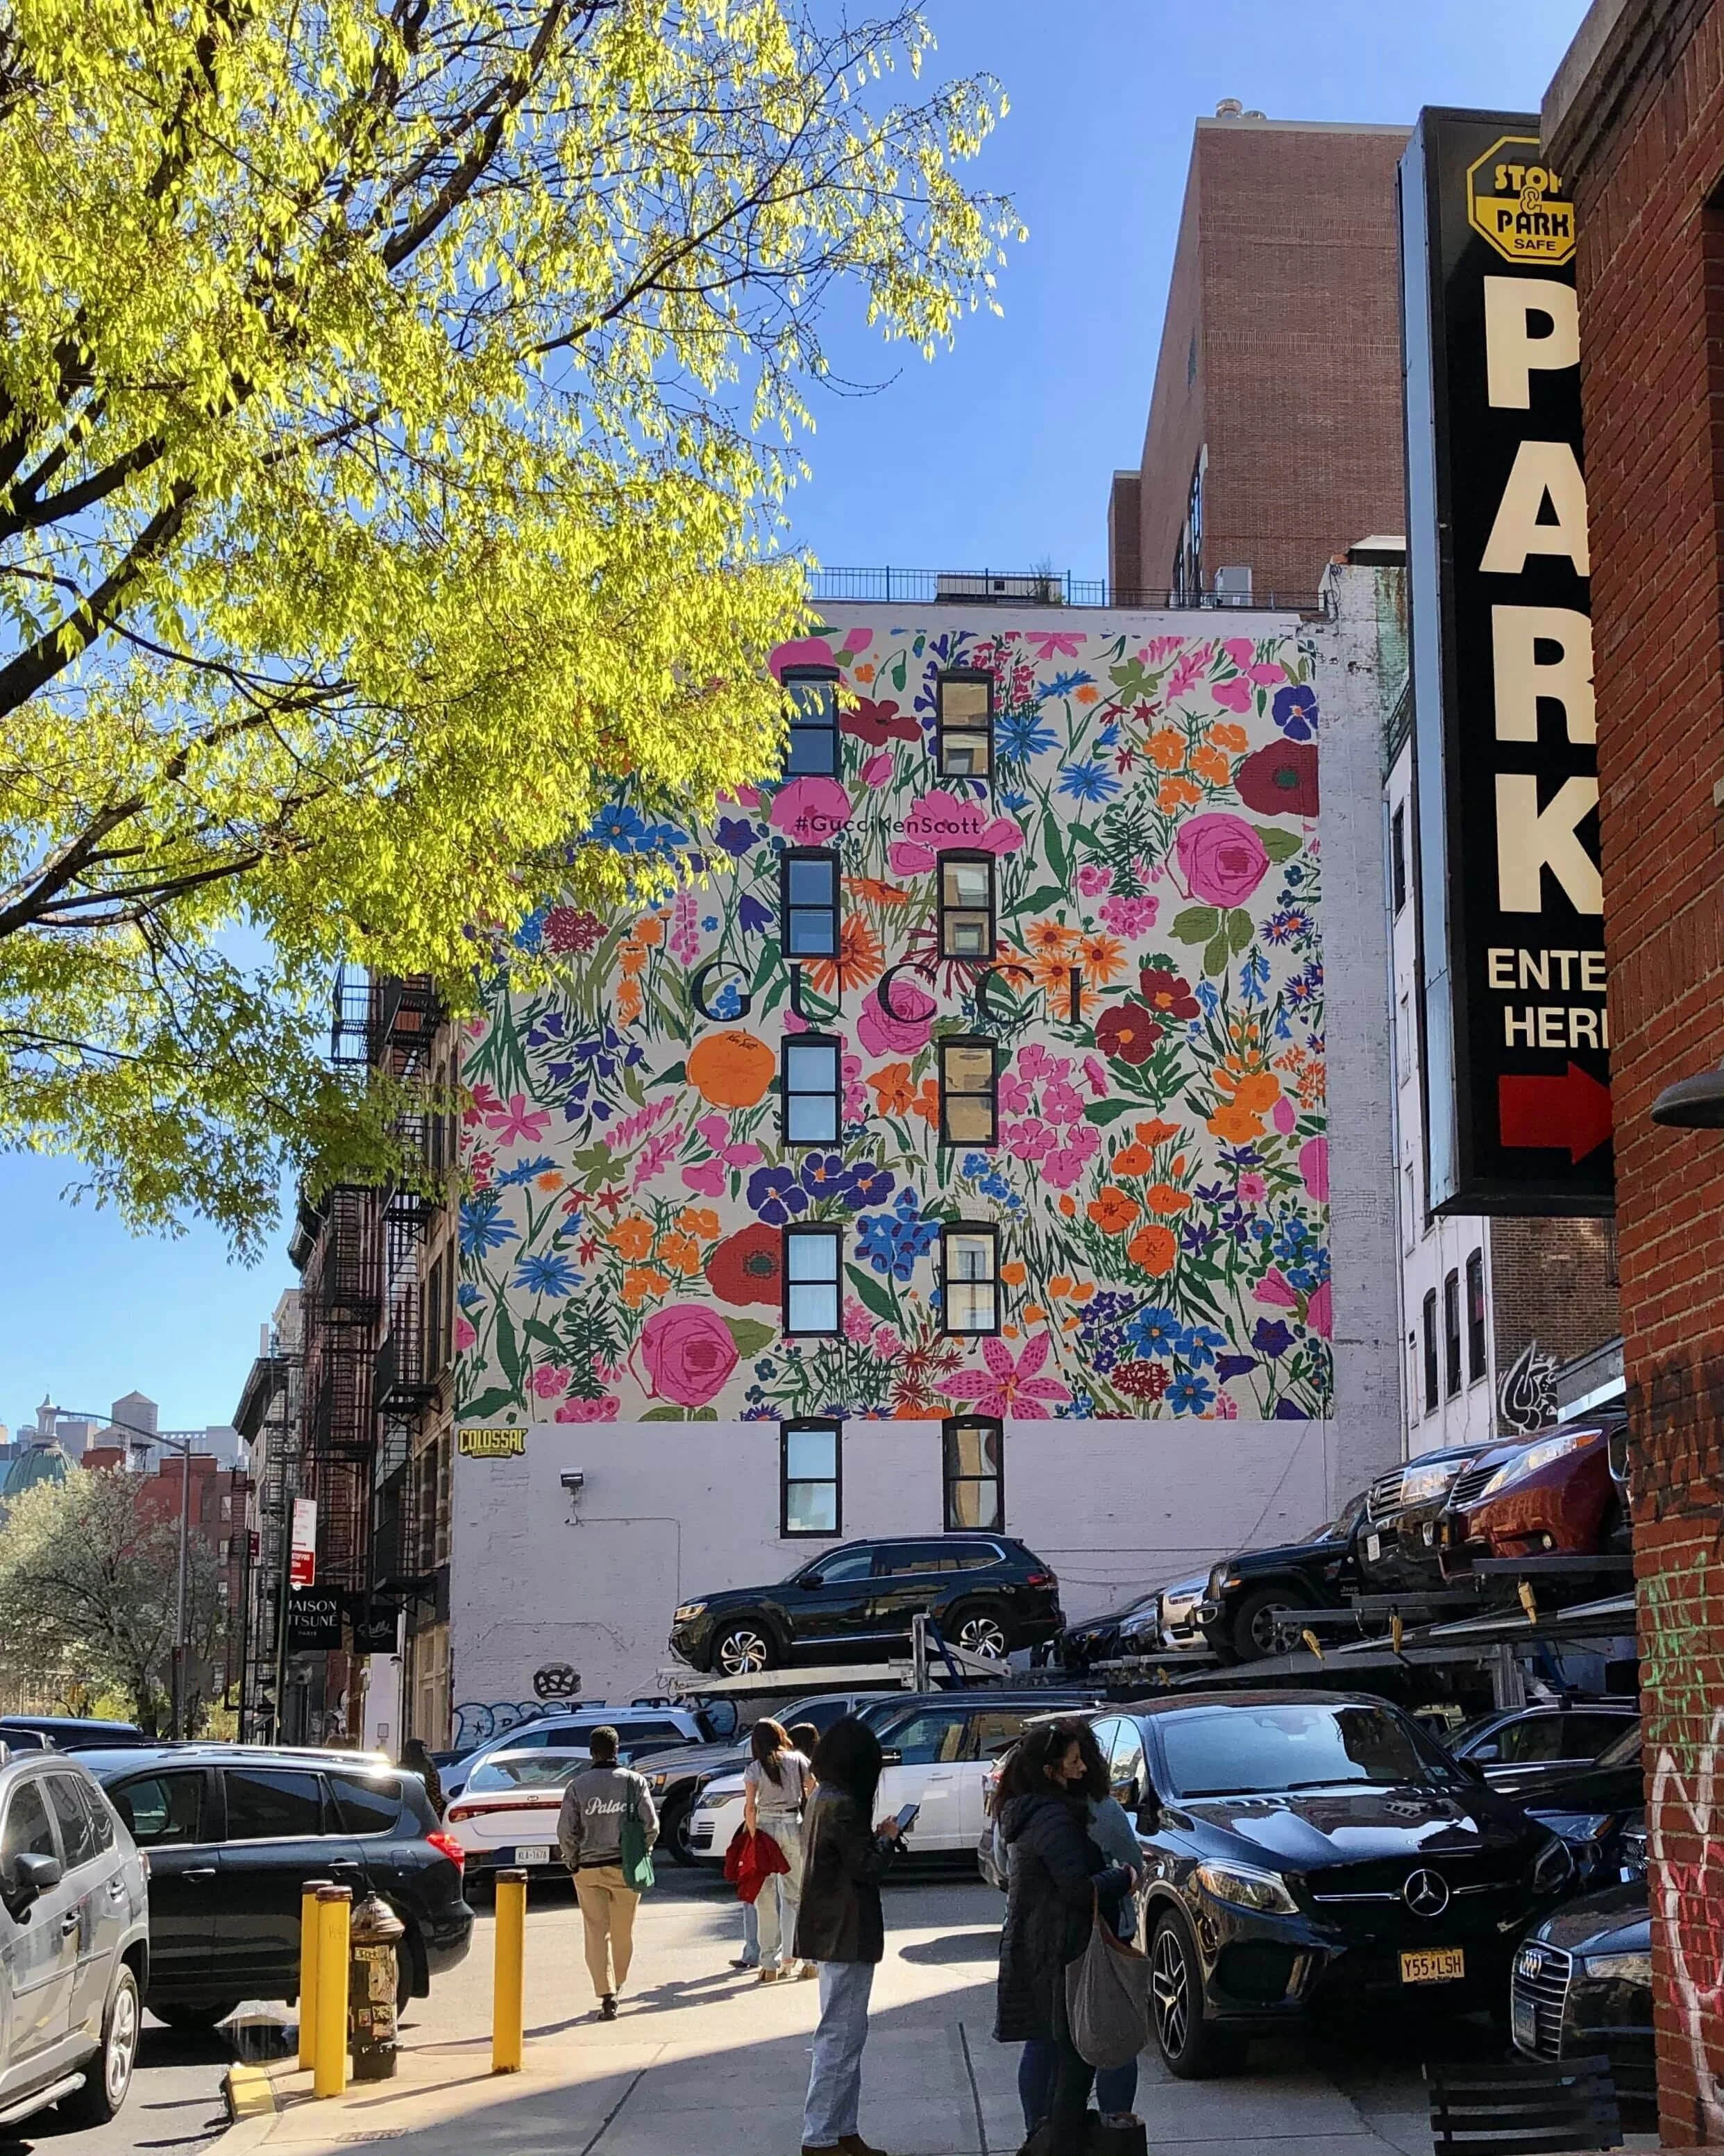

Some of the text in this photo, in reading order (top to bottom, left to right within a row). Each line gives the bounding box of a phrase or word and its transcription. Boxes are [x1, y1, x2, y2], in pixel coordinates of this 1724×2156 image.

[1521, 183, 1542, 214] &
[1496, 209, 1570, 238] PARK
[1514, 238, 1557, 251] SAFE
[1479, 275, 1605, 915] PARK
[1487, 948, 1607, 992] ENTE
[693, 961, 1083, 1026] GUCCI
[459, 1429, 524, 1454] COLOSSAL
[289, 1610, 338, 1627] ITSUNÉ
[584, 1796, 634, 1816] Palac
